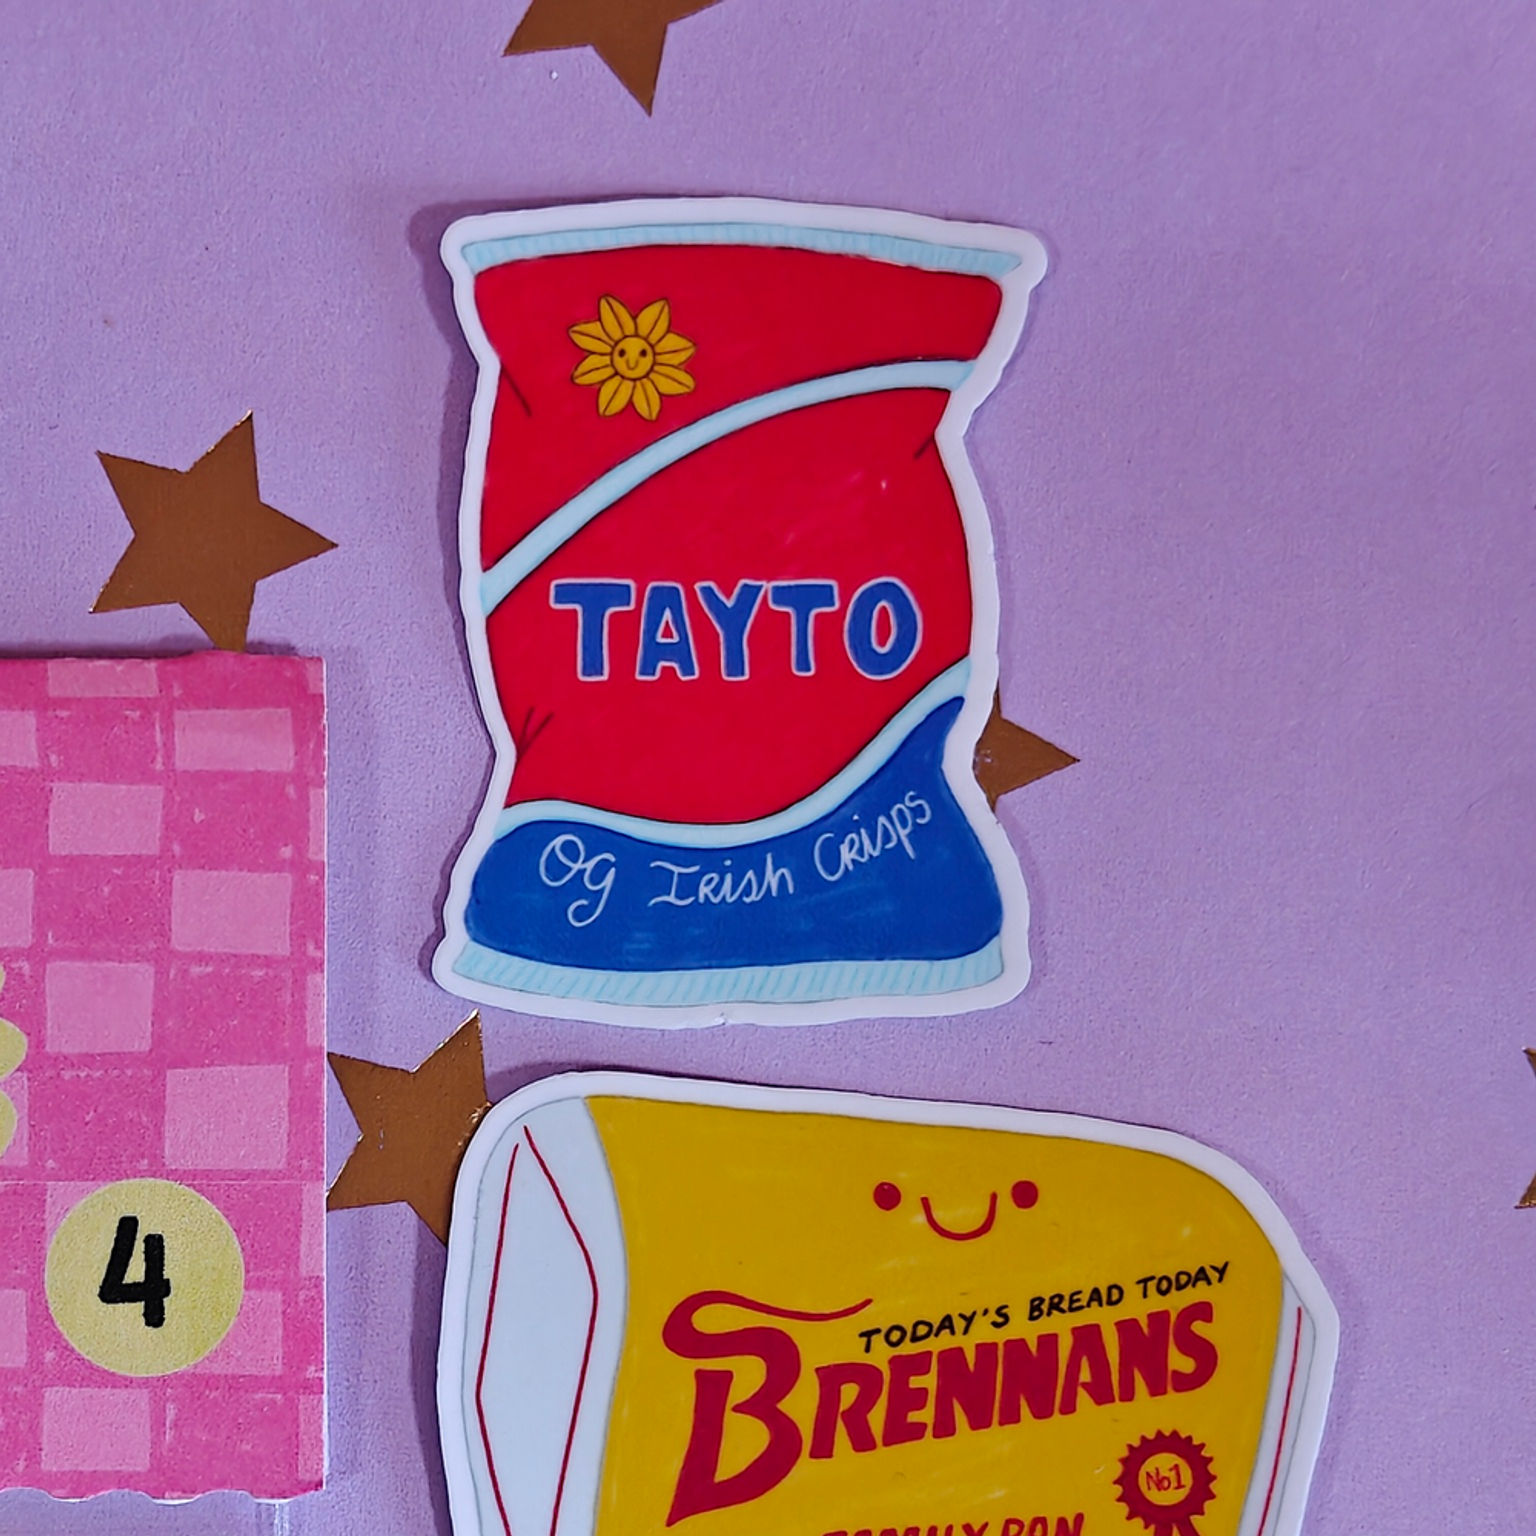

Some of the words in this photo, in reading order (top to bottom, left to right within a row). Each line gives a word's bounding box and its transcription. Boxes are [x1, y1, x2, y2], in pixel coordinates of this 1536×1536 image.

[549, 576, 923, 682] TAYTO
[538, 833, 616, 928] Og
[98, 1216, 173, 1330] 4
[858, 1304, 1010, 1355] TODAY'S
[1027, 1282, 1124, 1323] BREAD
[1135, 1260, 1230, 1300] TODAY
[662, 1290, 1219, 1528] BRENNANS
